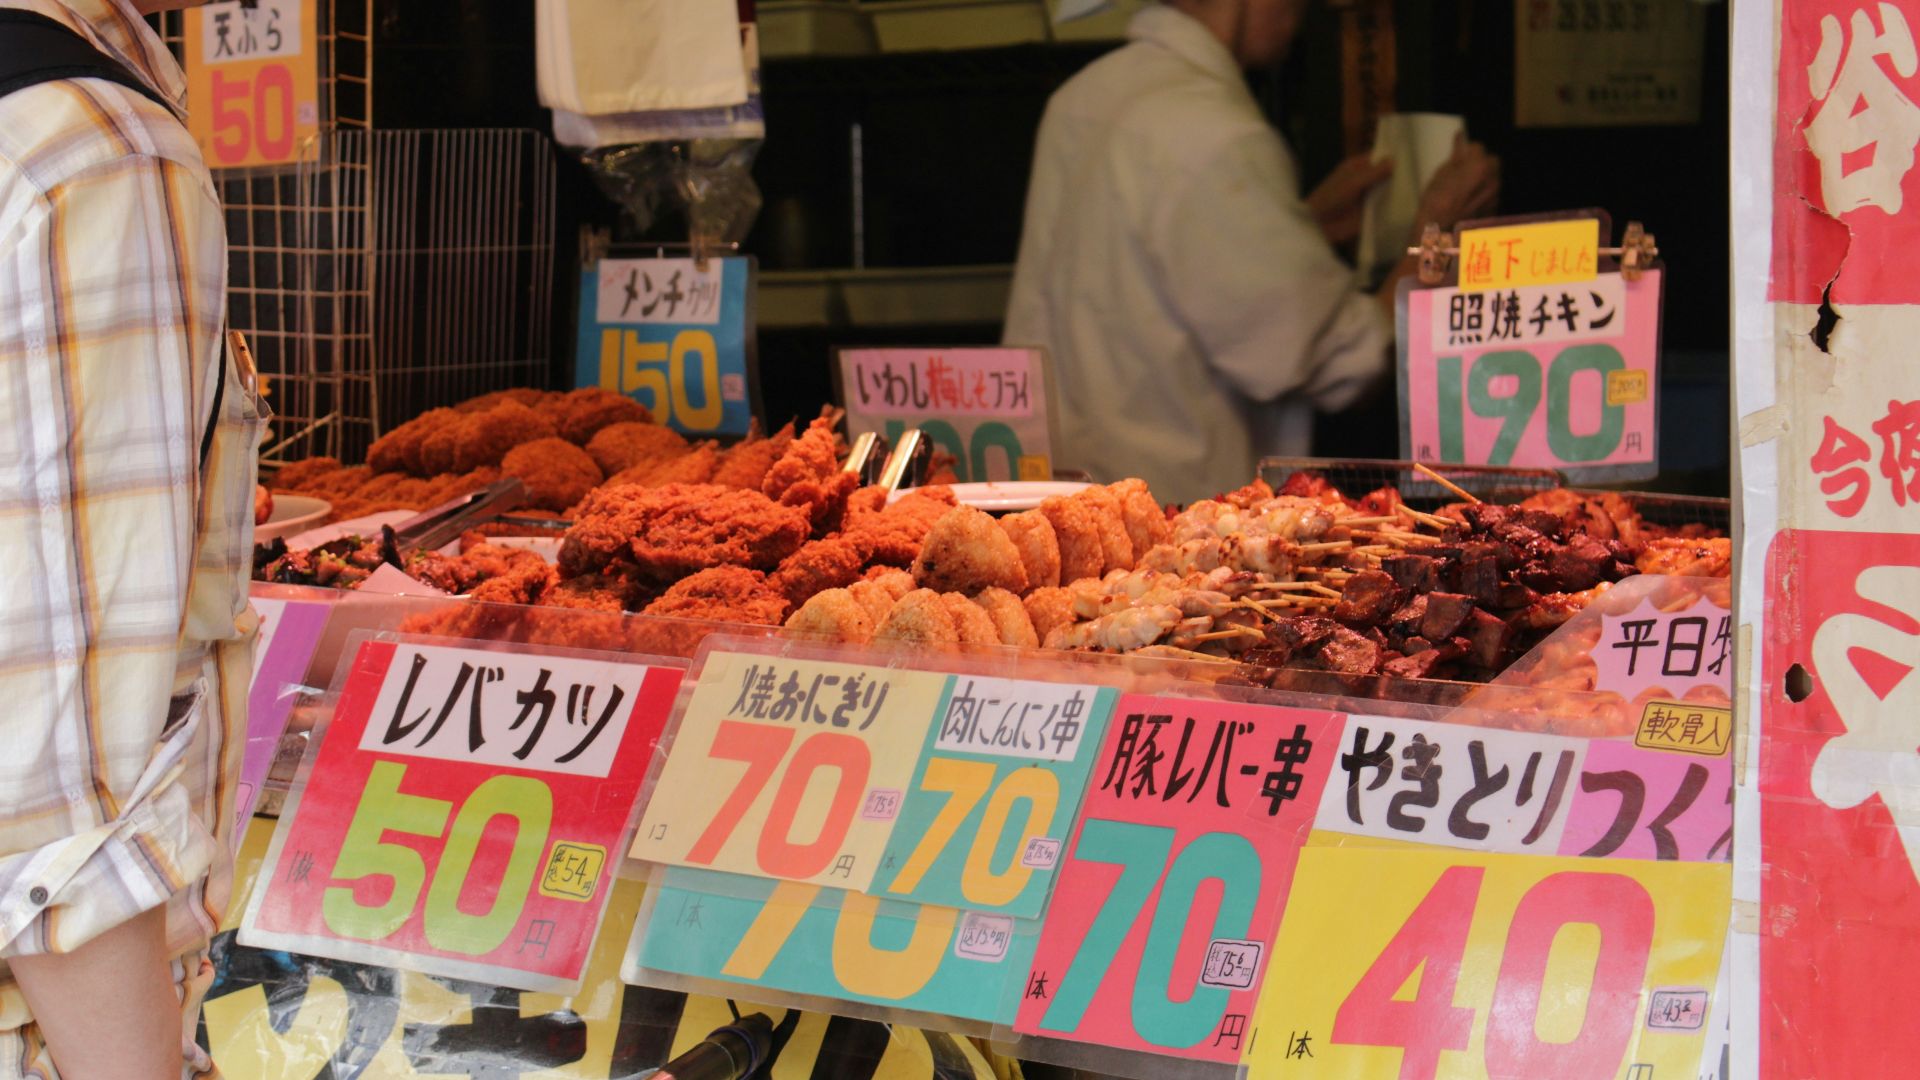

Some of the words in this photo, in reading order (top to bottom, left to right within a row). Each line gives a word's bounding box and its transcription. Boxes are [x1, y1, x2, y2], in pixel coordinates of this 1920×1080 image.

[211, 63, 295, 165] 50
[1449, 290, 1616, 345] 照焼チキン
[599, 328, 723, 431] 150
[1437, 343, 1626, 465] 190
[382, 652, 625, 764] レバカツ
[728, 664, 890, 731] 焼おにぎり
[939, 680, 1086, 754] 肉にんにく串
[684, 720, 872, 880] 70
[1101, 713, 1314, 817] 豚レバー串
[1341, 726, 1576, 845] やきとり
[323, 760, 554, 956] 50
[887, 757, 1061, 908] 70
[516, 919, 556, 960] 円
[1038, 818, 1262, 1049] 70
[1330, 864, 1655, 1080] 40
[1213, 1013, 1246, 1050] 円
[1285, 1030, 1314, 1060] 1本
